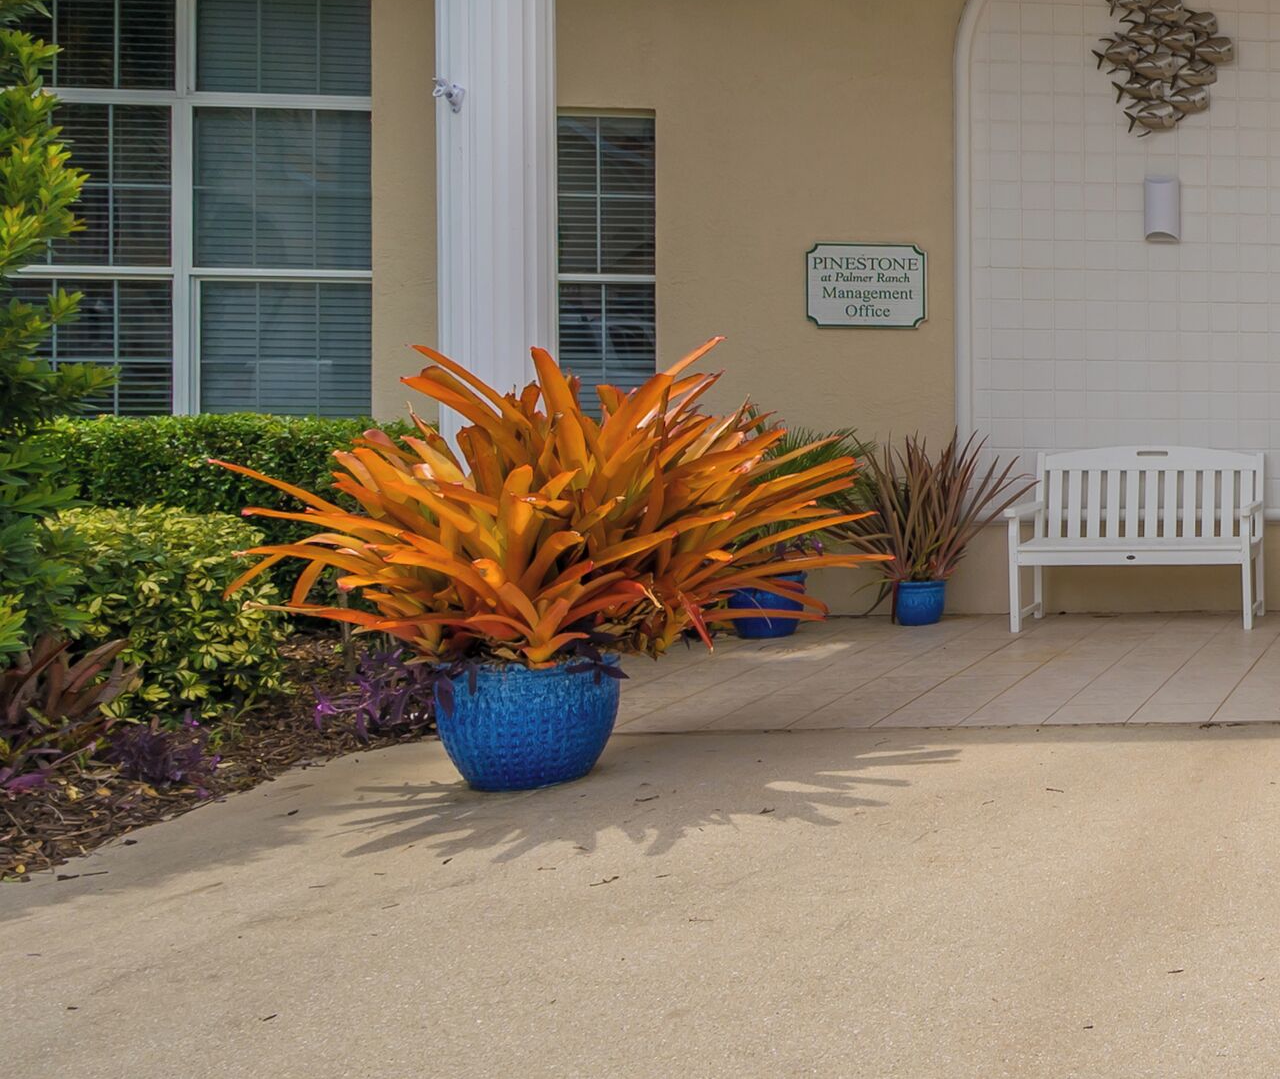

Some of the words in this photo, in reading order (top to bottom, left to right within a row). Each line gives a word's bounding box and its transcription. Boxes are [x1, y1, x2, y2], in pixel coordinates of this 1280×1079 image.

[812, 256, 919, 271] PINESTONE
[820, 274, 831, 283] at
[835, 272, 873, 283] Palmer
[876, 273, 910, 283] Ranch
[822, 286, 913, 302] Management
[845, 304, 891, 318] Office
